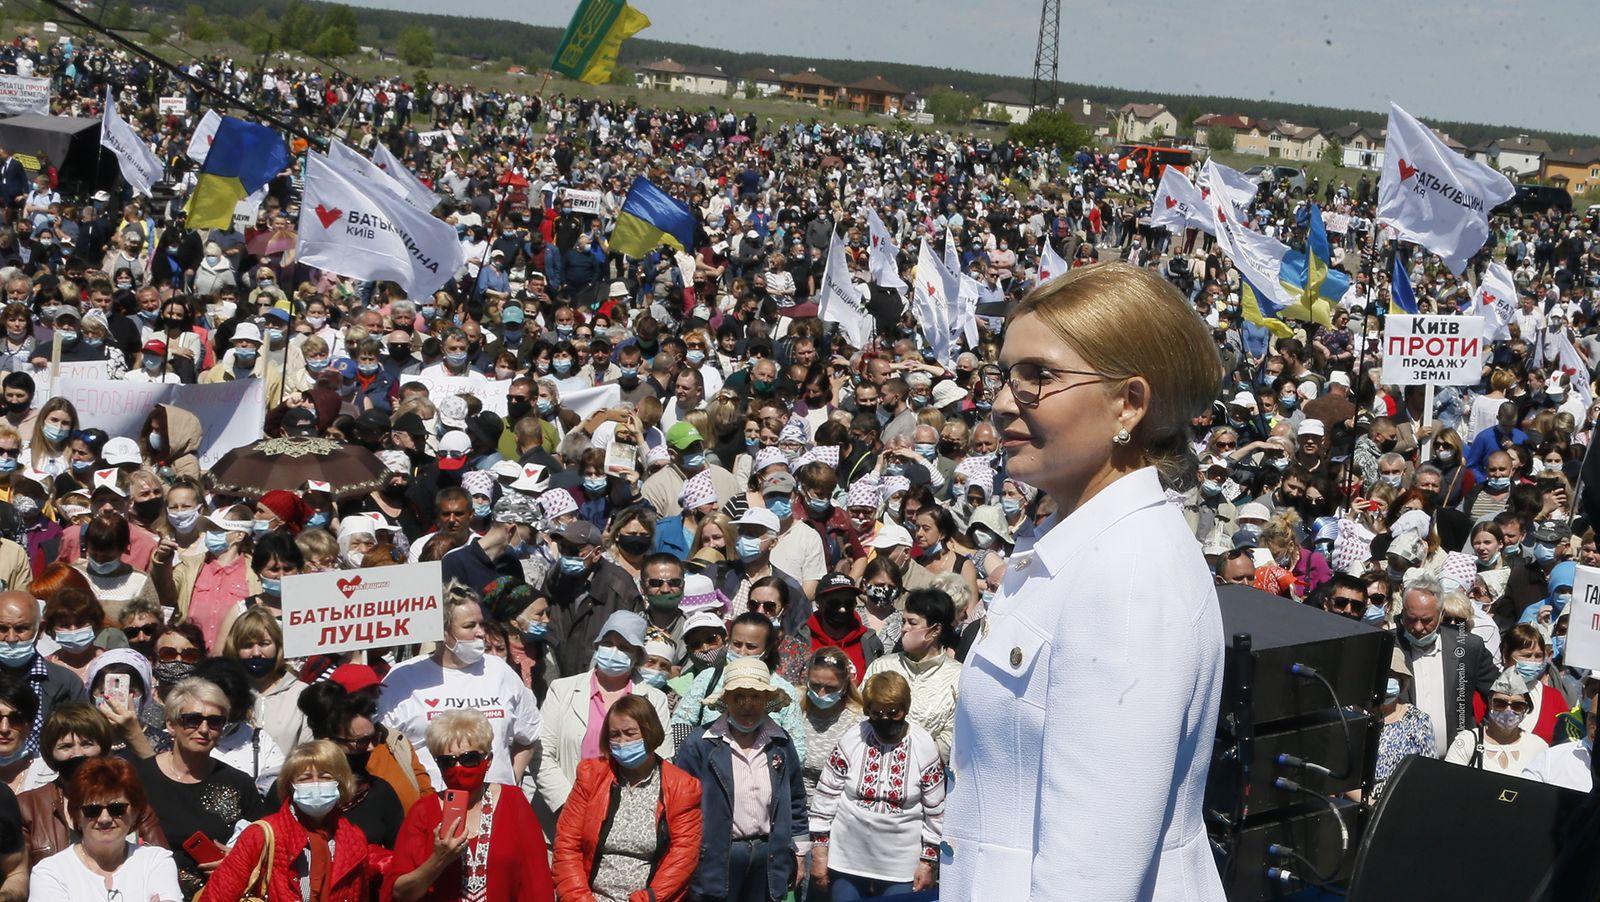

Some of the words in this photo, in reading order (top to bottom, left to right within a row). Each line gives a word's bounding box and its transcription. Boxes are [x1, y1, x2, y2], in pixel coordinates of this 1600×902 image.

[346, 225, 375, 240] КИЇВ
[1388, 336, 1479, 357] ПРОТИ
[1402, 358, 1468, 369] ПРОДАЖУ
[1412, 370, 1451, 381] ЗЕМЛІ
[1584, 584, 1600, 606] ГА
[289, 595, 438, 626] БАТЬКІВЩИНА
[317, 617, 411, 647] ЛУЦЬК
[444, 696, 502, 709] ЛУЦЬК
